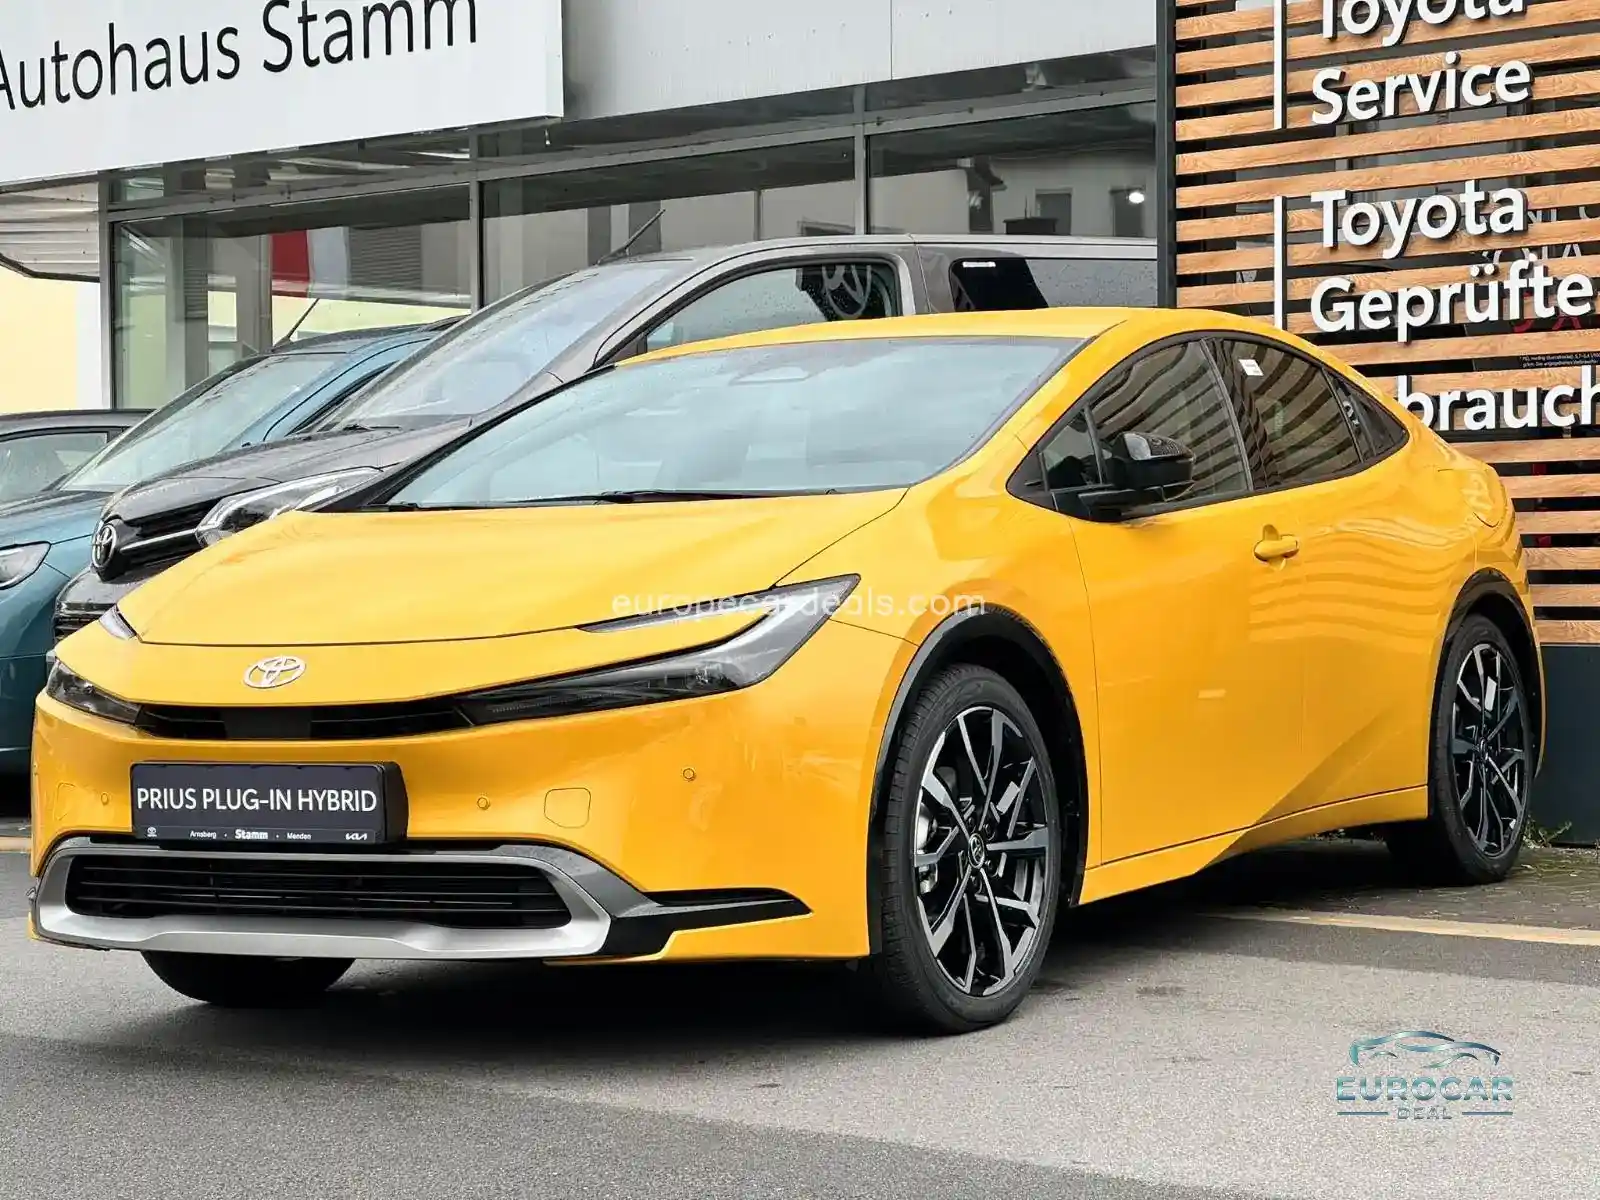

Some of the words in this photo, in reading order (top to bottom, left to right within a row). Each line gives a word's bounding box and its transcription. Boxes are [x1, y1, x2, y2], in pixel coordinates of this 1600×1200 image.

[262, 0, 478, 73] Stamm
[1321, 0, 1525, 47] Toyo
[1311, 52, 1534, 125] Service
[1310, 180, 1528, 259] Toyota
[1310, 254, 1595, 343] Geprüfte
[136, 787, 197, 810] PRIUS
[202, 788, 292, 811] PLUG-IN
[298, 789, 378, 812] HYBRID
[189, 830, 217, 840] Arnsberg
[235, 829, 269, 840] Stamm
